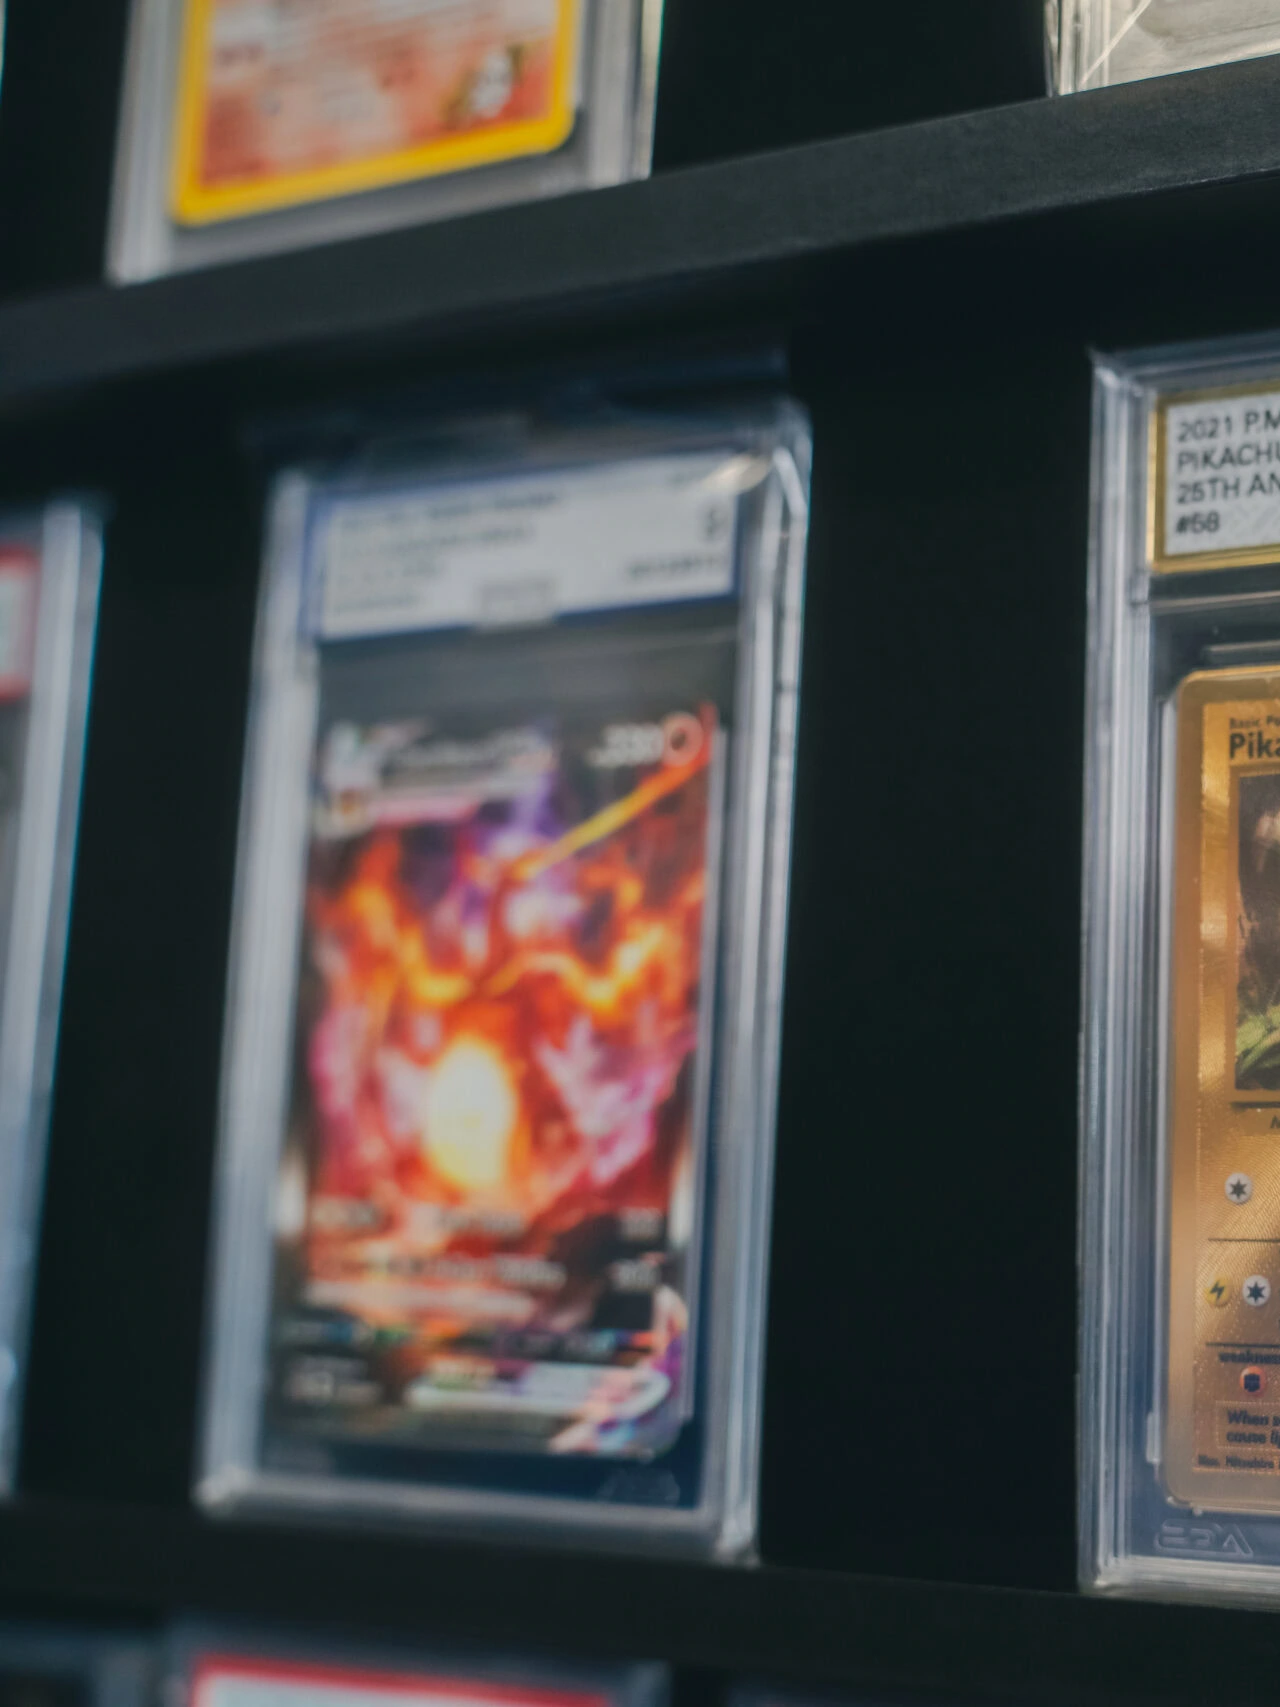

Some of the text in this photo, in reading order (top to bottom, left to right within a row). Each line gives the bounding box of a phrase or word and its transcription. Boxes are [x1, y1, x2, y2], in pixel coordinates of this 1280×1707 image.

[1177, 415, 1233, 443] 2021
[1177, 477, 1241, 505] 25TH
[1227, 1409, 1270, 1426] When
